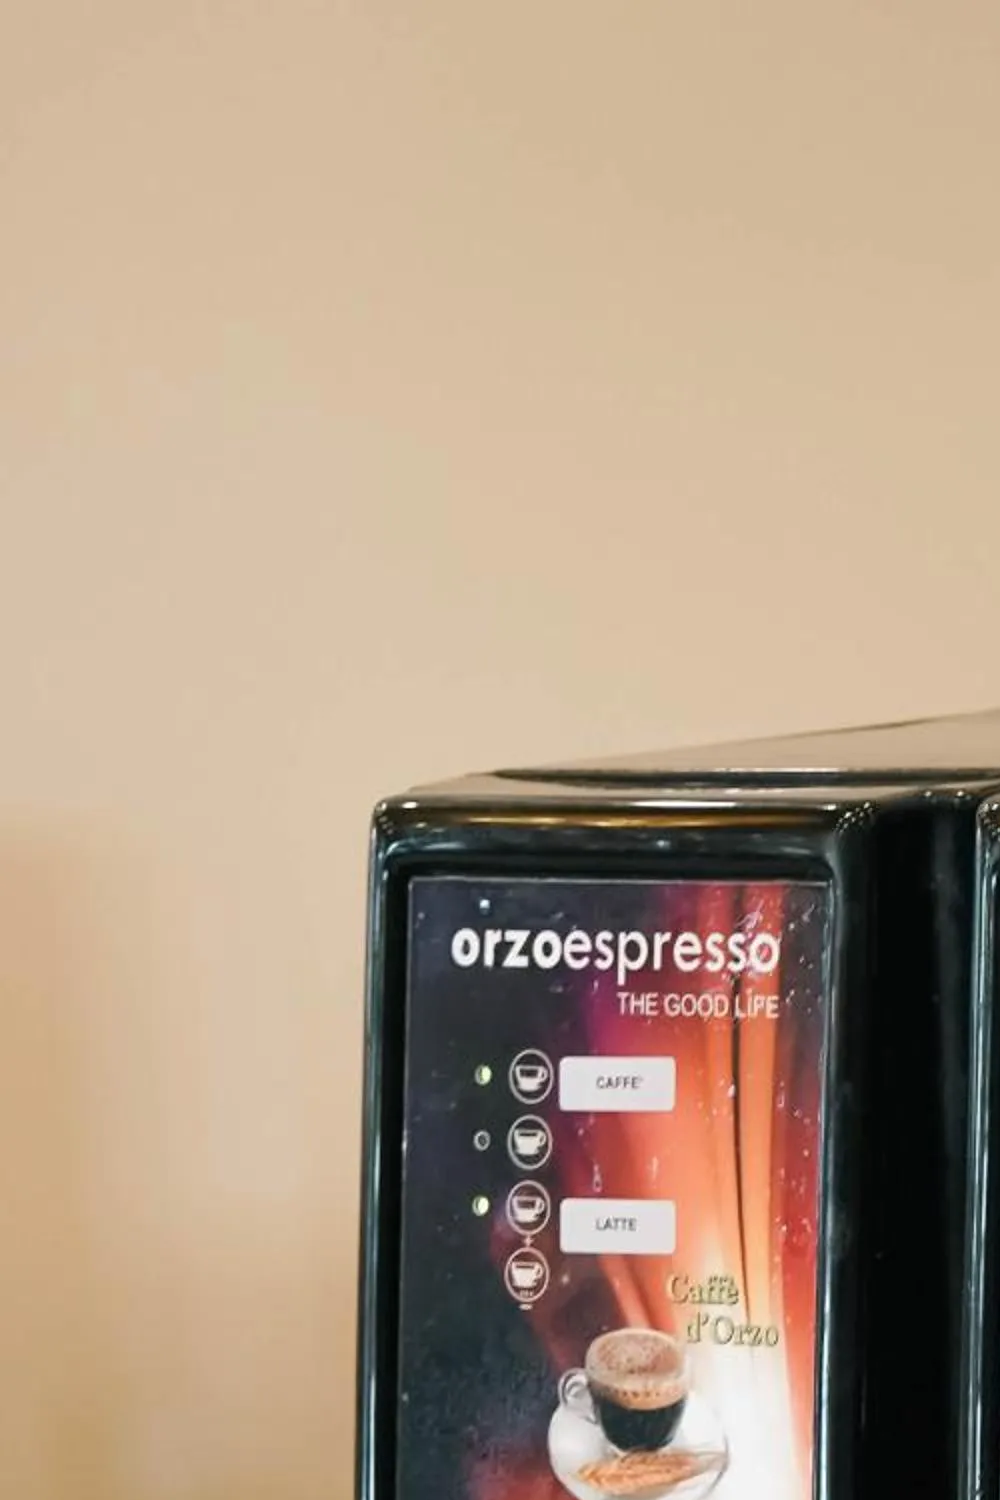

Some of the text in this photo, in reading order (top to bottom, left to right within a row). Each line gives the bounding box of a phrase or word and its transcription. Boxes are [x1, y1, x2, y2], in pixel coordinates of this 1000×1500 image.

[451, 926, 782, 984] orzoespresso
[617, 991, 779, 1019] THE GOOD LIFE
[595, 1217, 637, 1232] LATTE
